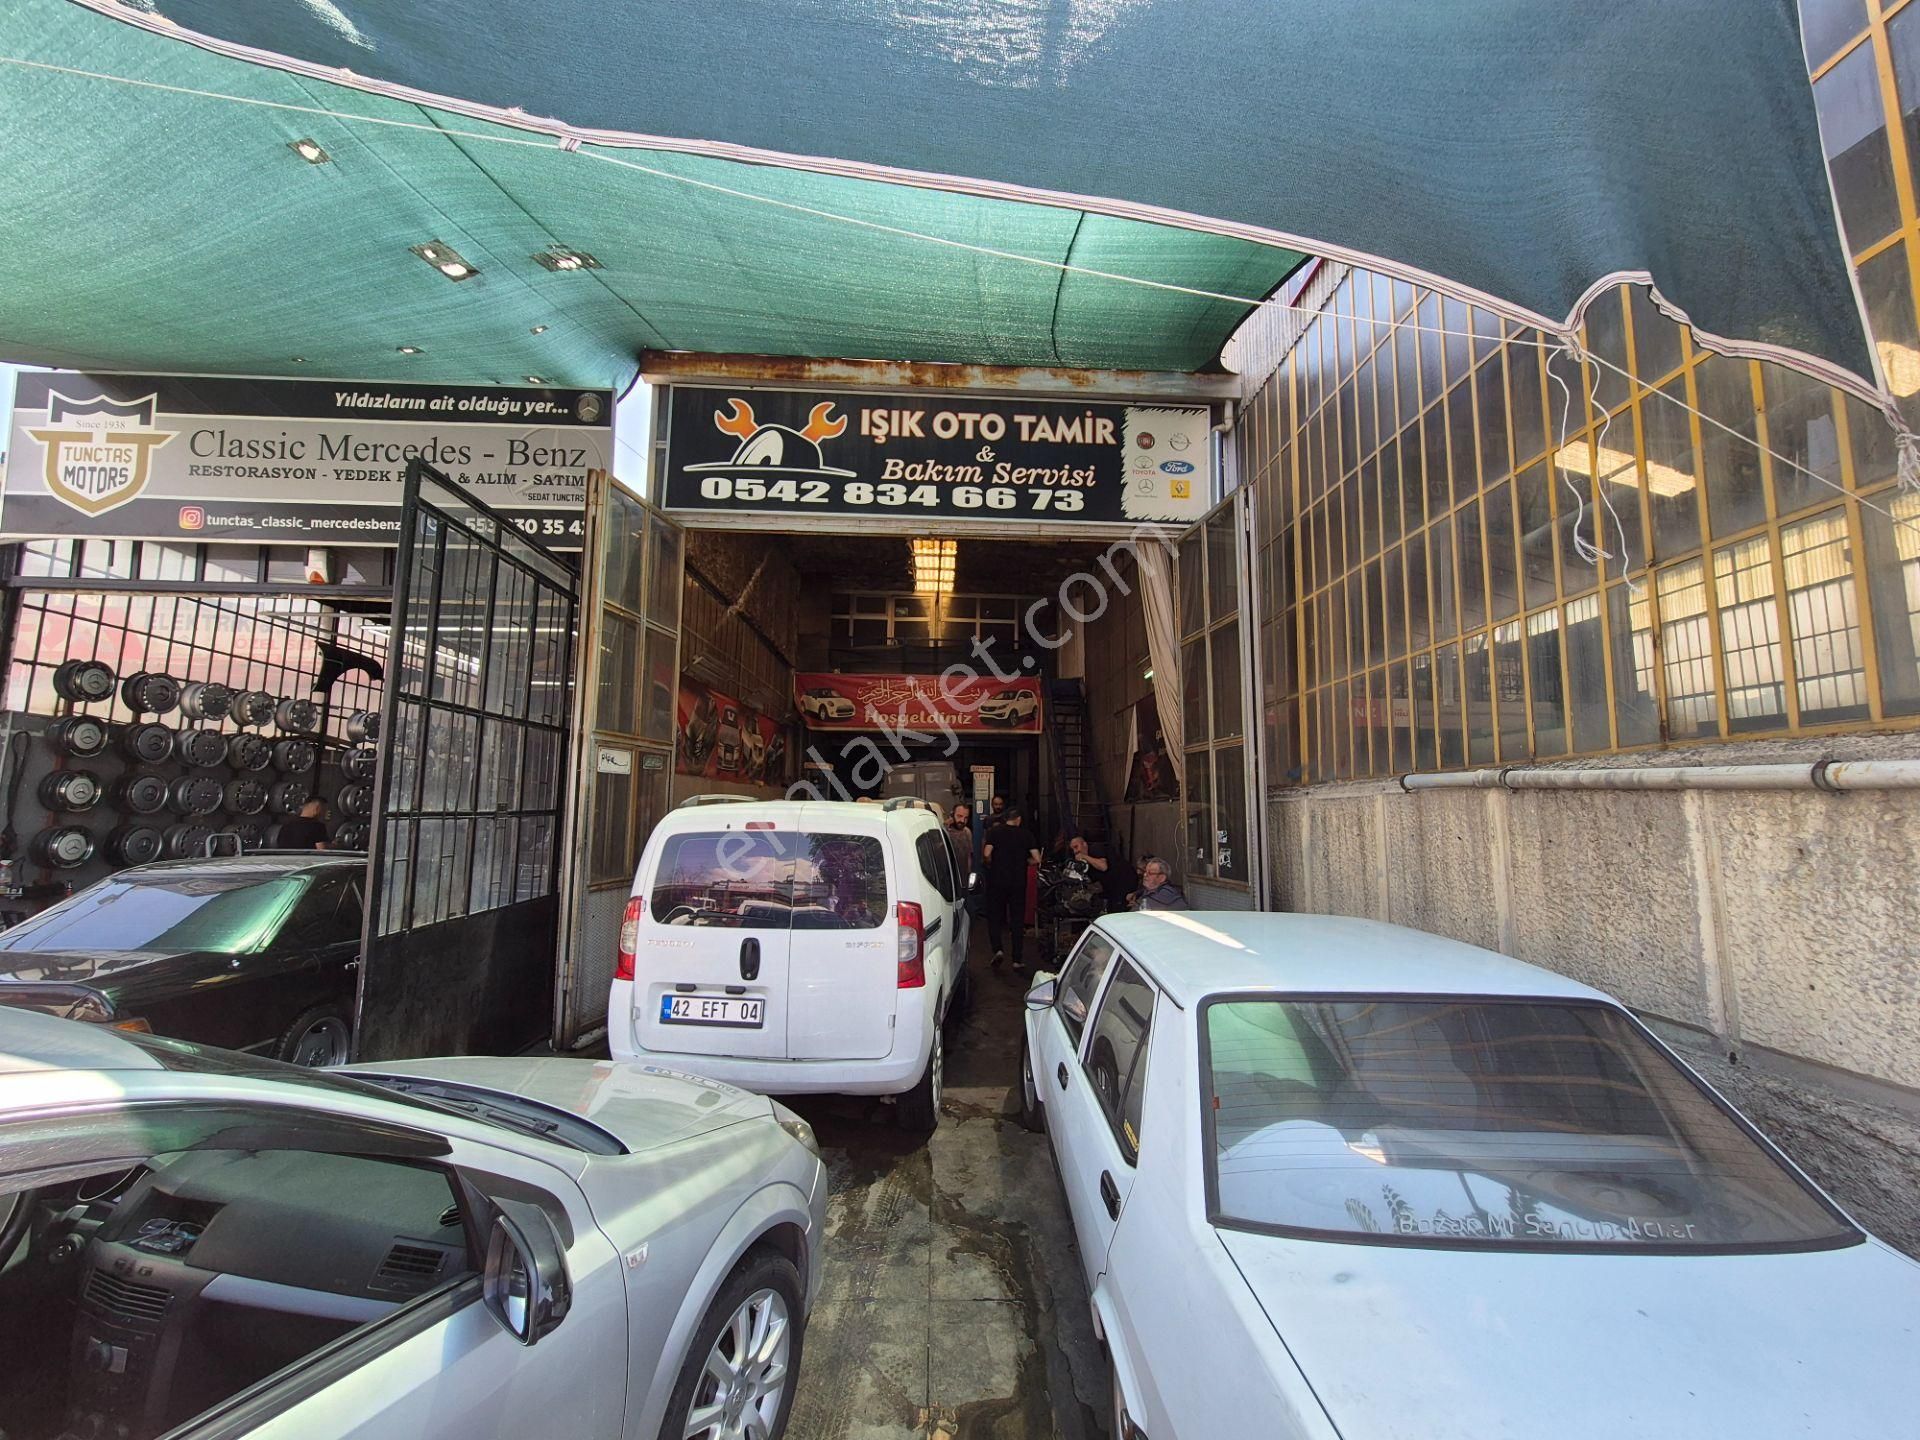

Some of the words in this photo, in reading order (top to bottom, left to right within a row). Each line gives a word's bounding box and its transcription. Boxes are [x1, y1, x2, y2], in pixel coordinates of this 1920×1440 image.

[334, 392, 426, 410] Yıldızların
[429, 394, 455, 411] ait
[457, 397, 521, 416] olduğu
[523, 401, 569, 416] yer...
[75, 419, 101, 429] Since
[104, 420, 126, 429] 1938
[860, 408, 926, 444] IŞIK
[932, 410, 1006, 441] OTO
[1013, 409, 1117, 445] TAMİR
[189, 430, 305, 460] Classic
[317, 433, 471, 465] Mercedes
[506, 438, 587, 467] Benz
[975, 445, 997, 463] &
[63, 465, 129, 494] MOTORS
[188, 464, 317, 479] RESTORASYON
[333, 469, 391, 482] YEDEK
[475, 473, 517, 485] ALIM
[533, 475, 585, 487] SATIM
[881, 458, 983, 482] Bakım
[992, 462, 1097, 487] Servisi
[527, 492, 551, 501] SEDAT
[700, 477, 831, 503] 0542
[843, 482, 941, 506] 834
[952, 486, 1017, 510] 66
[1028, 488, 1085, 512] 73
[542, 519, 565, 535] 35
[568, 519, 584, 536] 4
[864, 710, 973, 727] Hoşgeldiniz
[672, 999, 690, 1017] 42
[701, 1001, 729, 1019] EFT
[740, 1002, 758, 1021] 04
